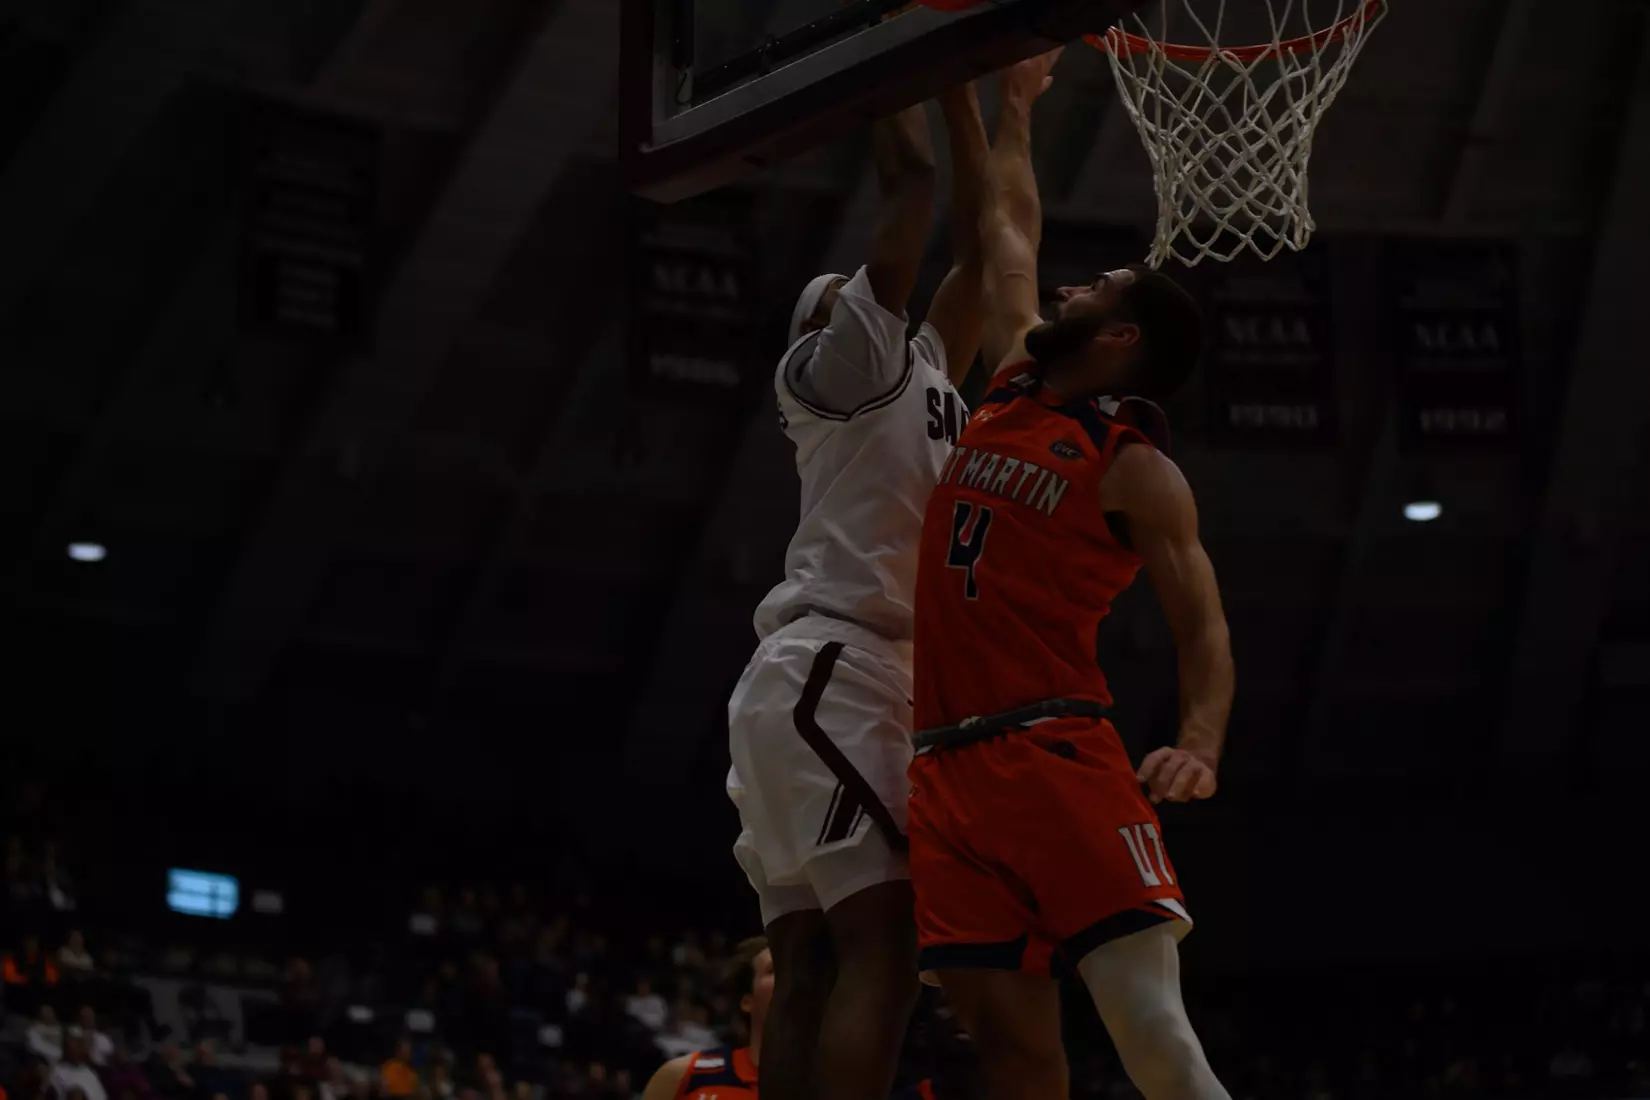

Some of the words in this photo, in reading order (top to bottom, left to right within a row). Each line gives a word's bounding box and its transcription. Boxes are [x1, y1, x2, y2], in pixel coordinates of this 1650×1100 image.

[1416, 322, 1500, 351] NCAA
[959, 450, 1069, 517] MARTIN
[945, 499, 993, 601] 4
